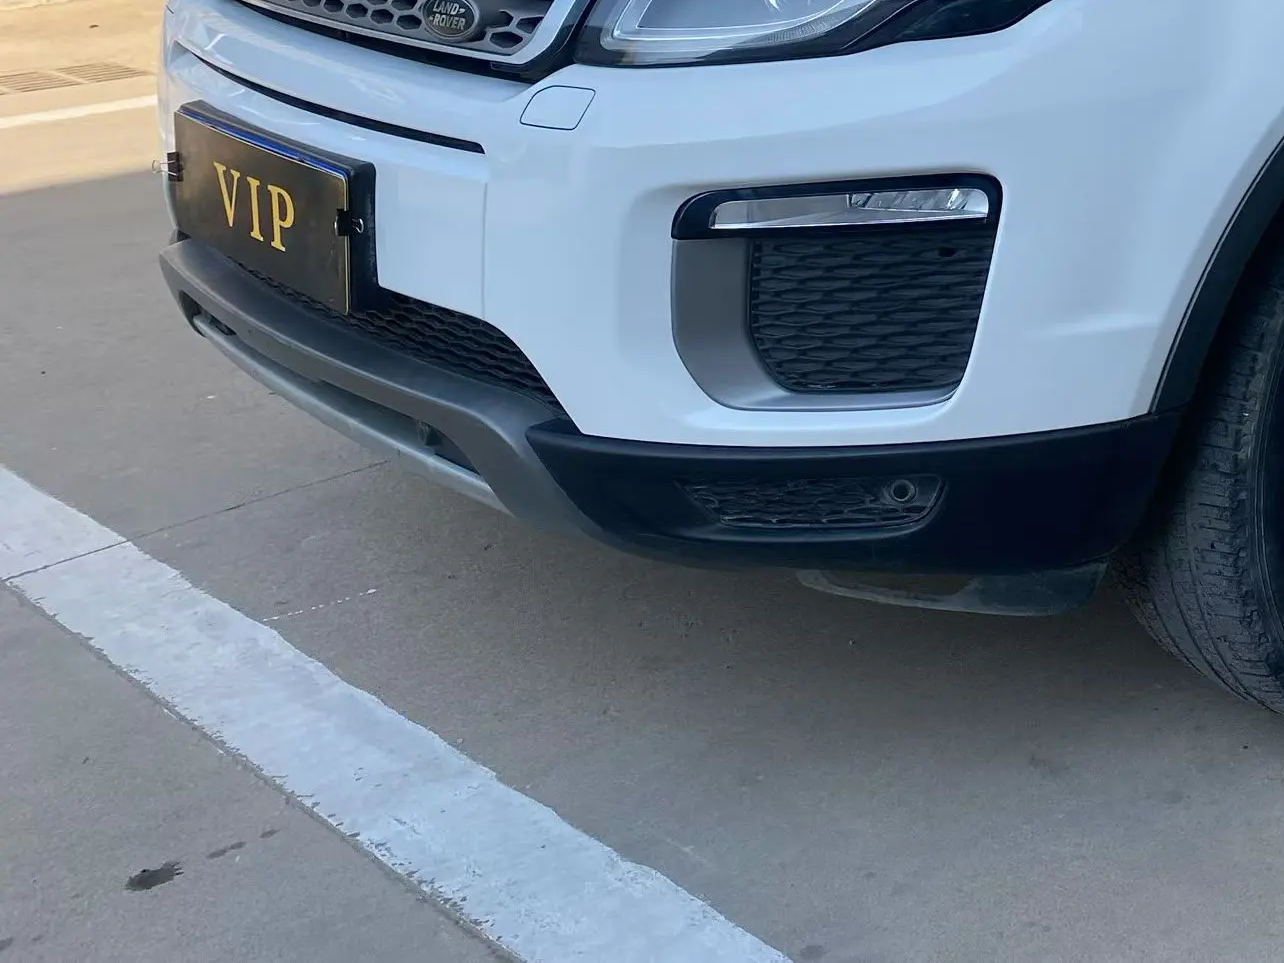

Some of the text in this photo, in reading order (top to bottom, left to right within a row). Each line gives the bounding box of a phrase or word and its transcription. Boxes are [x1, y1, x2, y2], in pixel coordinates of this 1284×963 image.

[433, 0, 460, 15] LAND
[433, 13, 466, 30] ROVER
[213, 161, 295, 252] VIP
